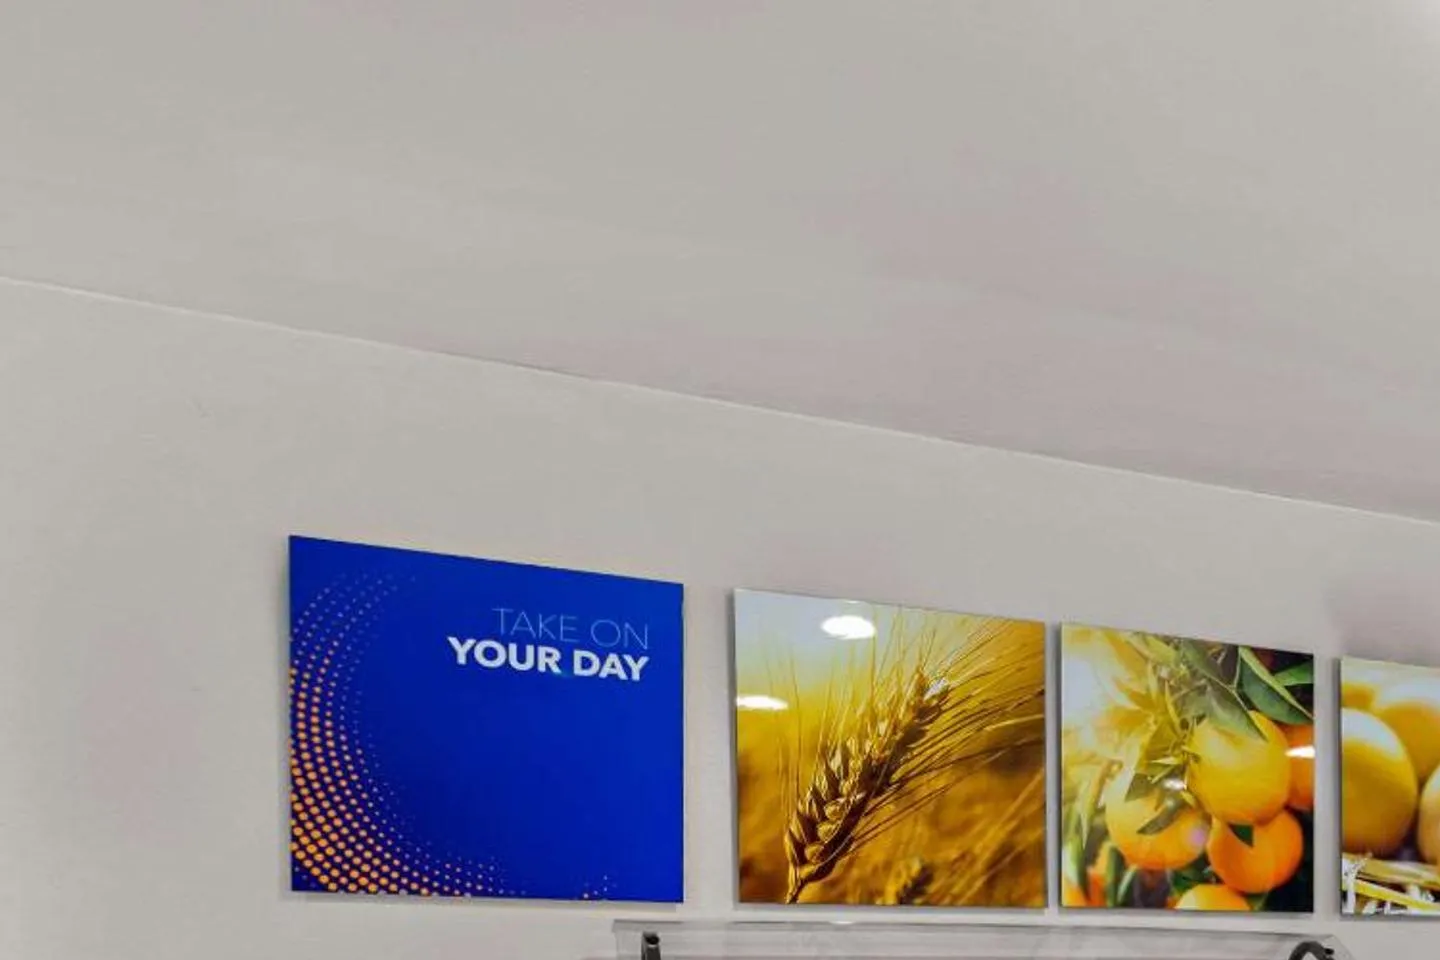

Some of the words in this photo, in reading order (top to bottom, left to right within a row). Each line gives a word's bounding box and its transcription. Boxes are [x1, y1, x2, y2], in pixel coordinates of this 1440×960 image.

[492, 607, 580, 643] TAKE
[590, 619, 648, 650] ON
[447, 636, 562, 674] YOUR
[573, 649, 649, 681] DAY
